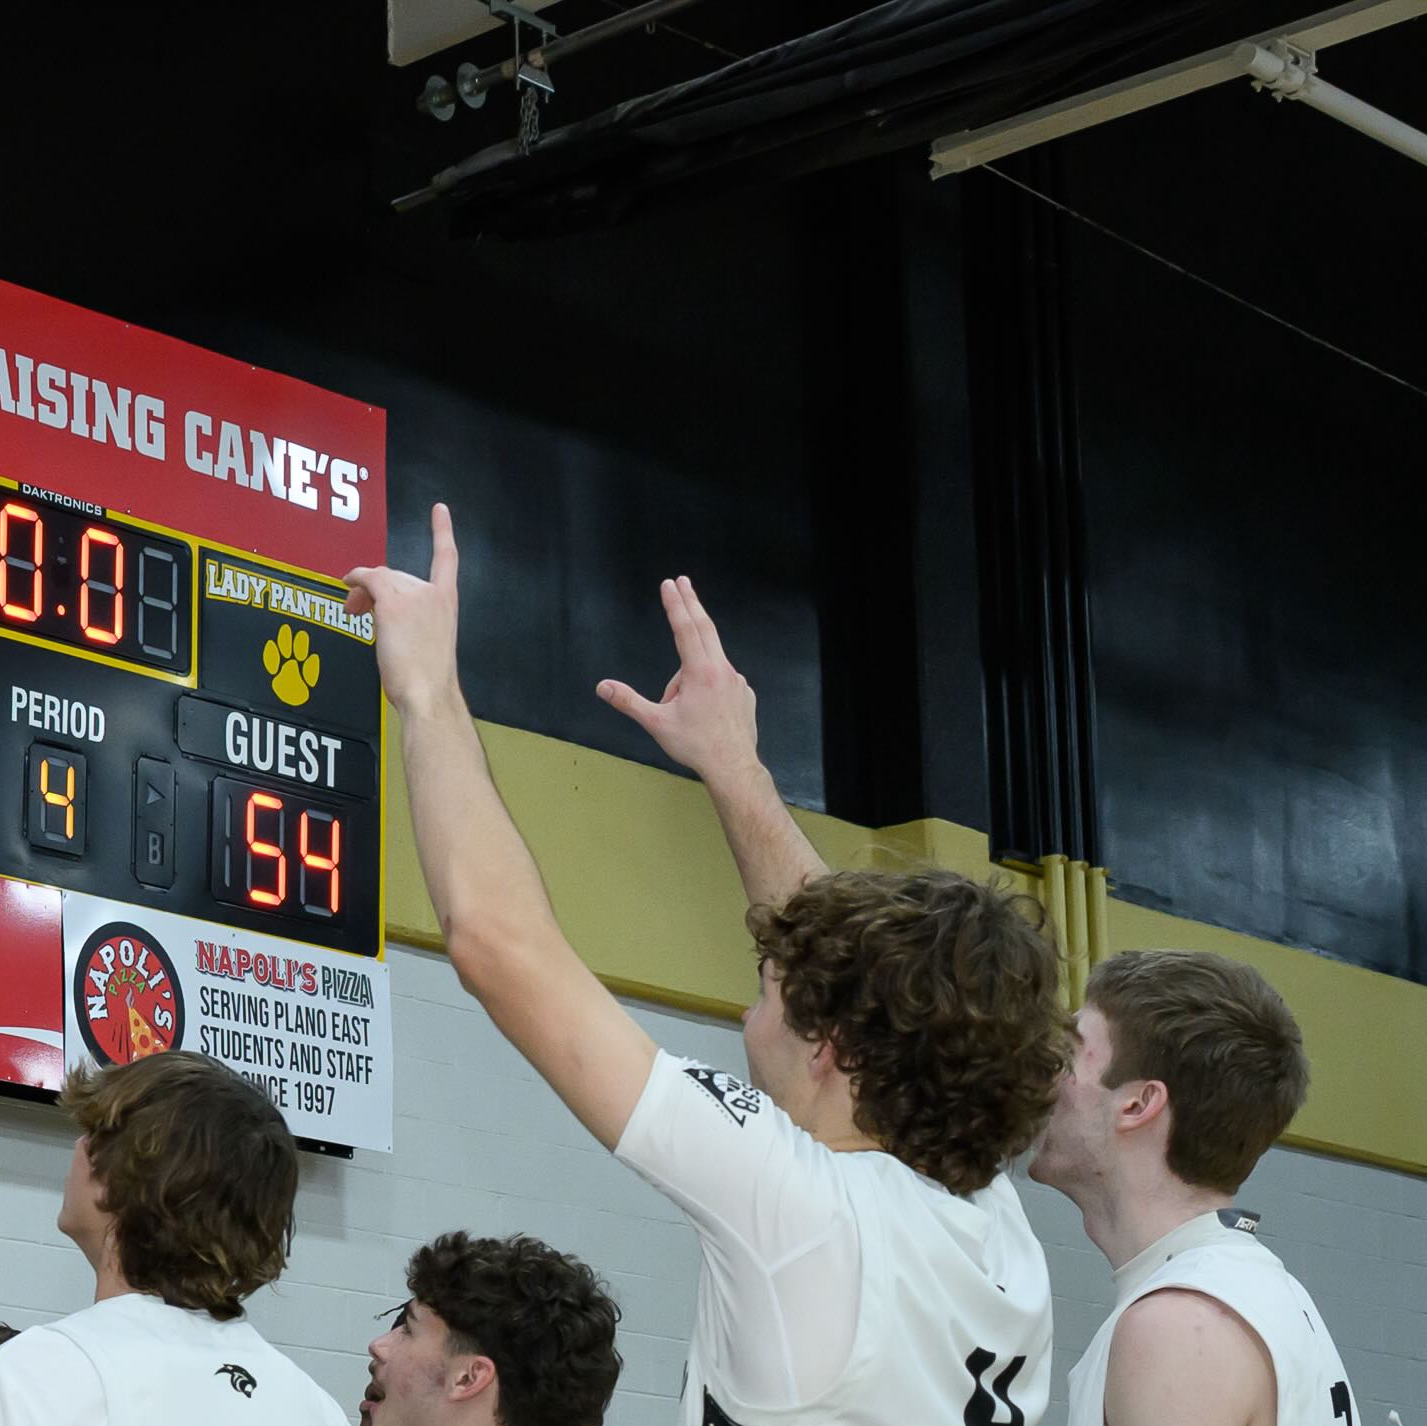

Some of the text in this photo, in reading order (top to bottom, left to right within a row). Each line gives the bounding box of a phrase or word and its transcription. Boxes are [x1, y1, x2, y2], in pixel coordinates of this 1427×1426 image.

[185, 410, 361, 522] CANE'S
[22, 483, 103, 517] DAKTRONICS
[207, 563, 267, 605] LADY
[10, 685, 106, 744] PERIOD
[225, 711, 342, 788] GUEST
[39, 758, 76, 840] 4
[246, 791, 341, 914] 54
[194, 938, 374, 1009] NAPOLI'S PIZZA
[199, 985, 370, 1047] SERVING PLANO EAST
[199, 1024, 373, 1085] STUDENTS AND STAFF
[294, 1081, 336, 1116] 1997
